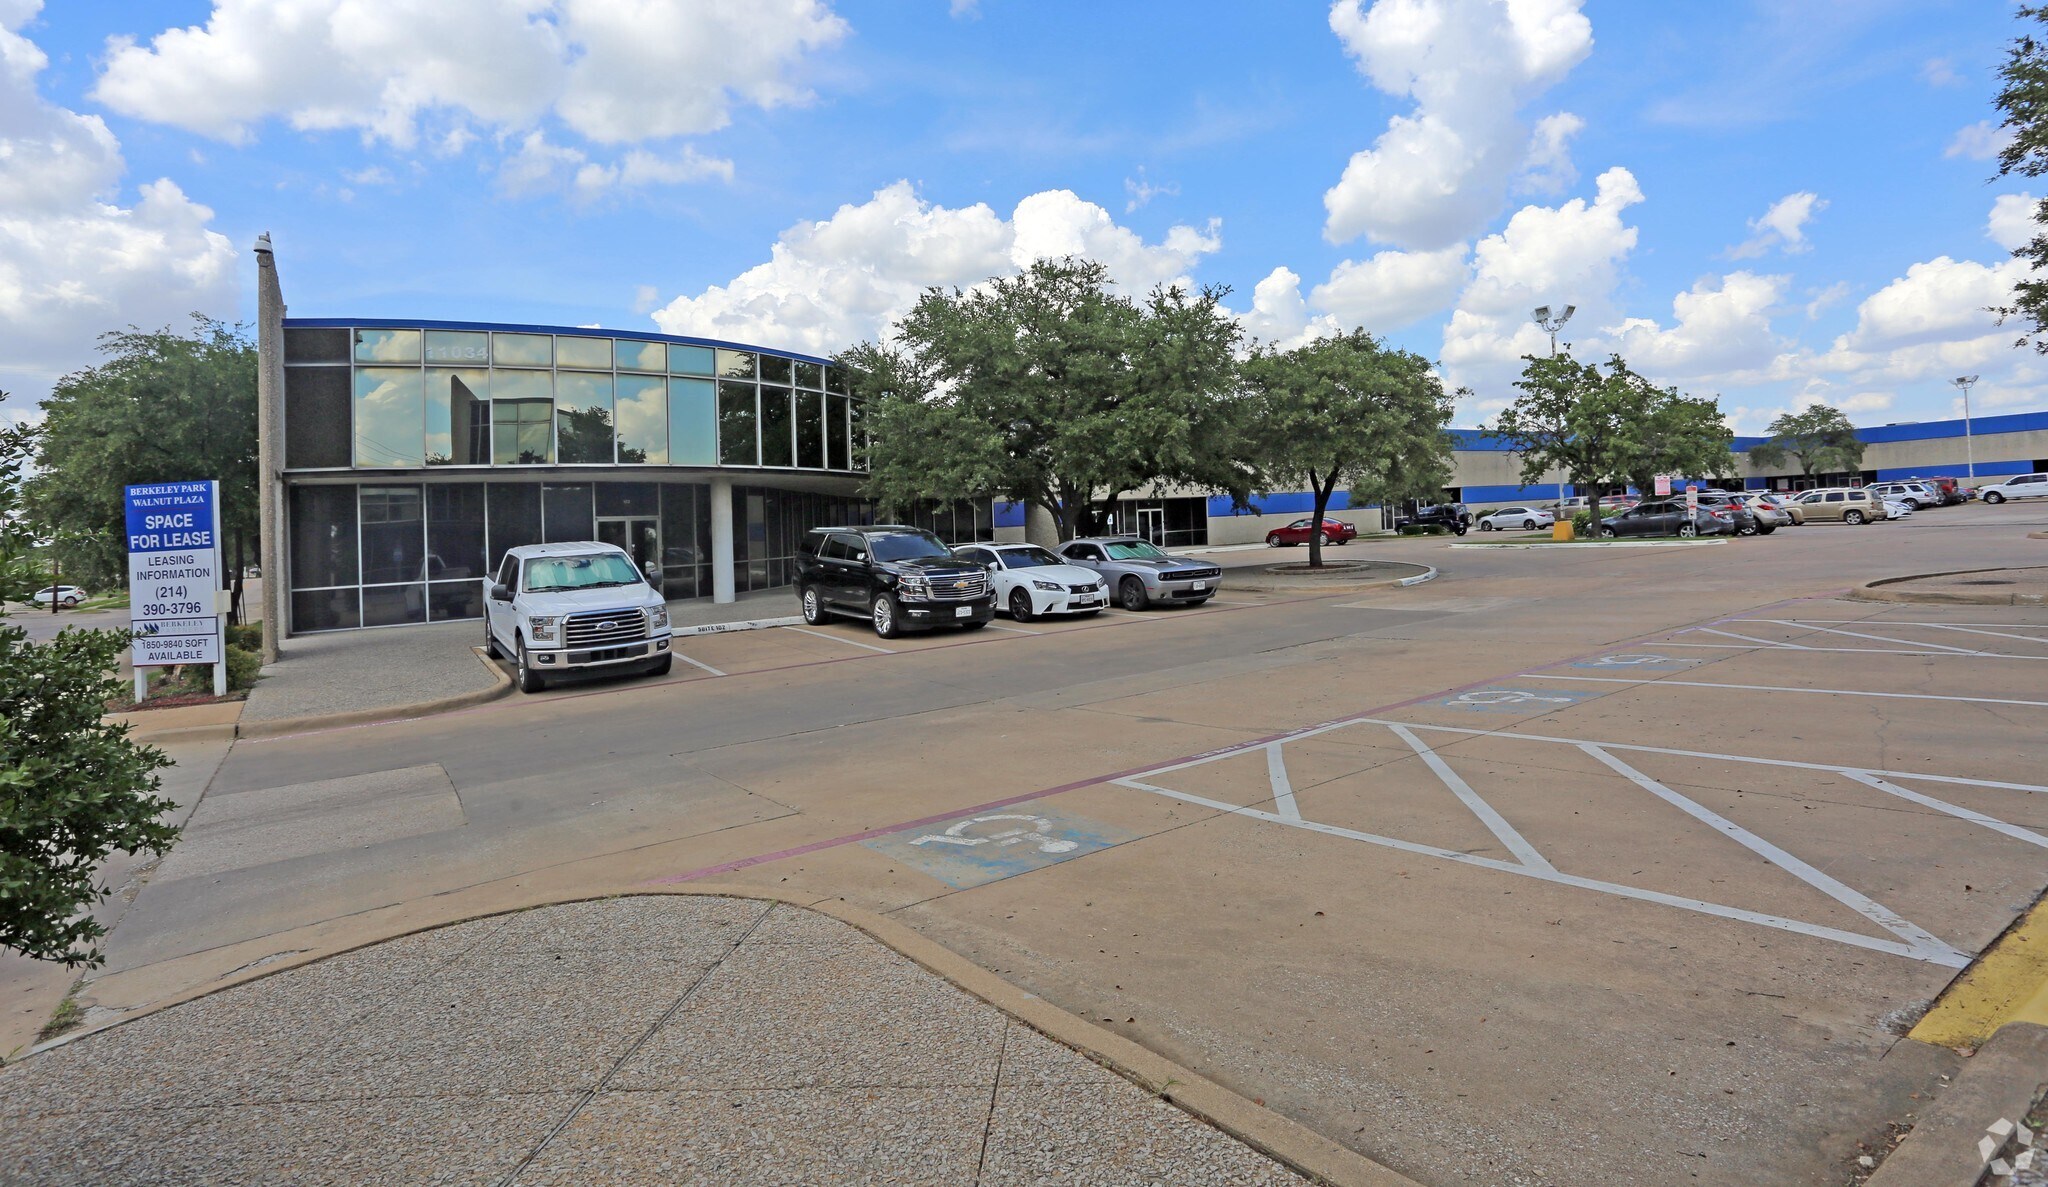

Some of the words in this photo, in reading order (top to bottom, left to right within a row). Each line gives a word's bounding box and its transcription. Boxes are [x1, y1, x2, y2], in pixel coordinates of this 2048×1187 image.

[425, 346, 488, 359] 11034
[130, 485, 180, 496] BERKELEY
[181, 483, 207, 493] PARK
[133, 497, 173, 507] WALNUT
[174, 495, 204, 505] PLAZA
[145, 513, 193, 530] SPACE
[130, 534, 160, 549] FOR
[163, 531, 211, 547] LEASE
[148, 554, 194, 567] LEASING
[136, 568, 210, 581] INFORMATION
[155, 585, 188, 600] (214)
[143, 601, 201, 616] 390-3796
[142, 639, 183, 650] 1850-9840
[184, 638, 208, 648] SQFT
[148, 650, 203, 661] AVAILABLE
